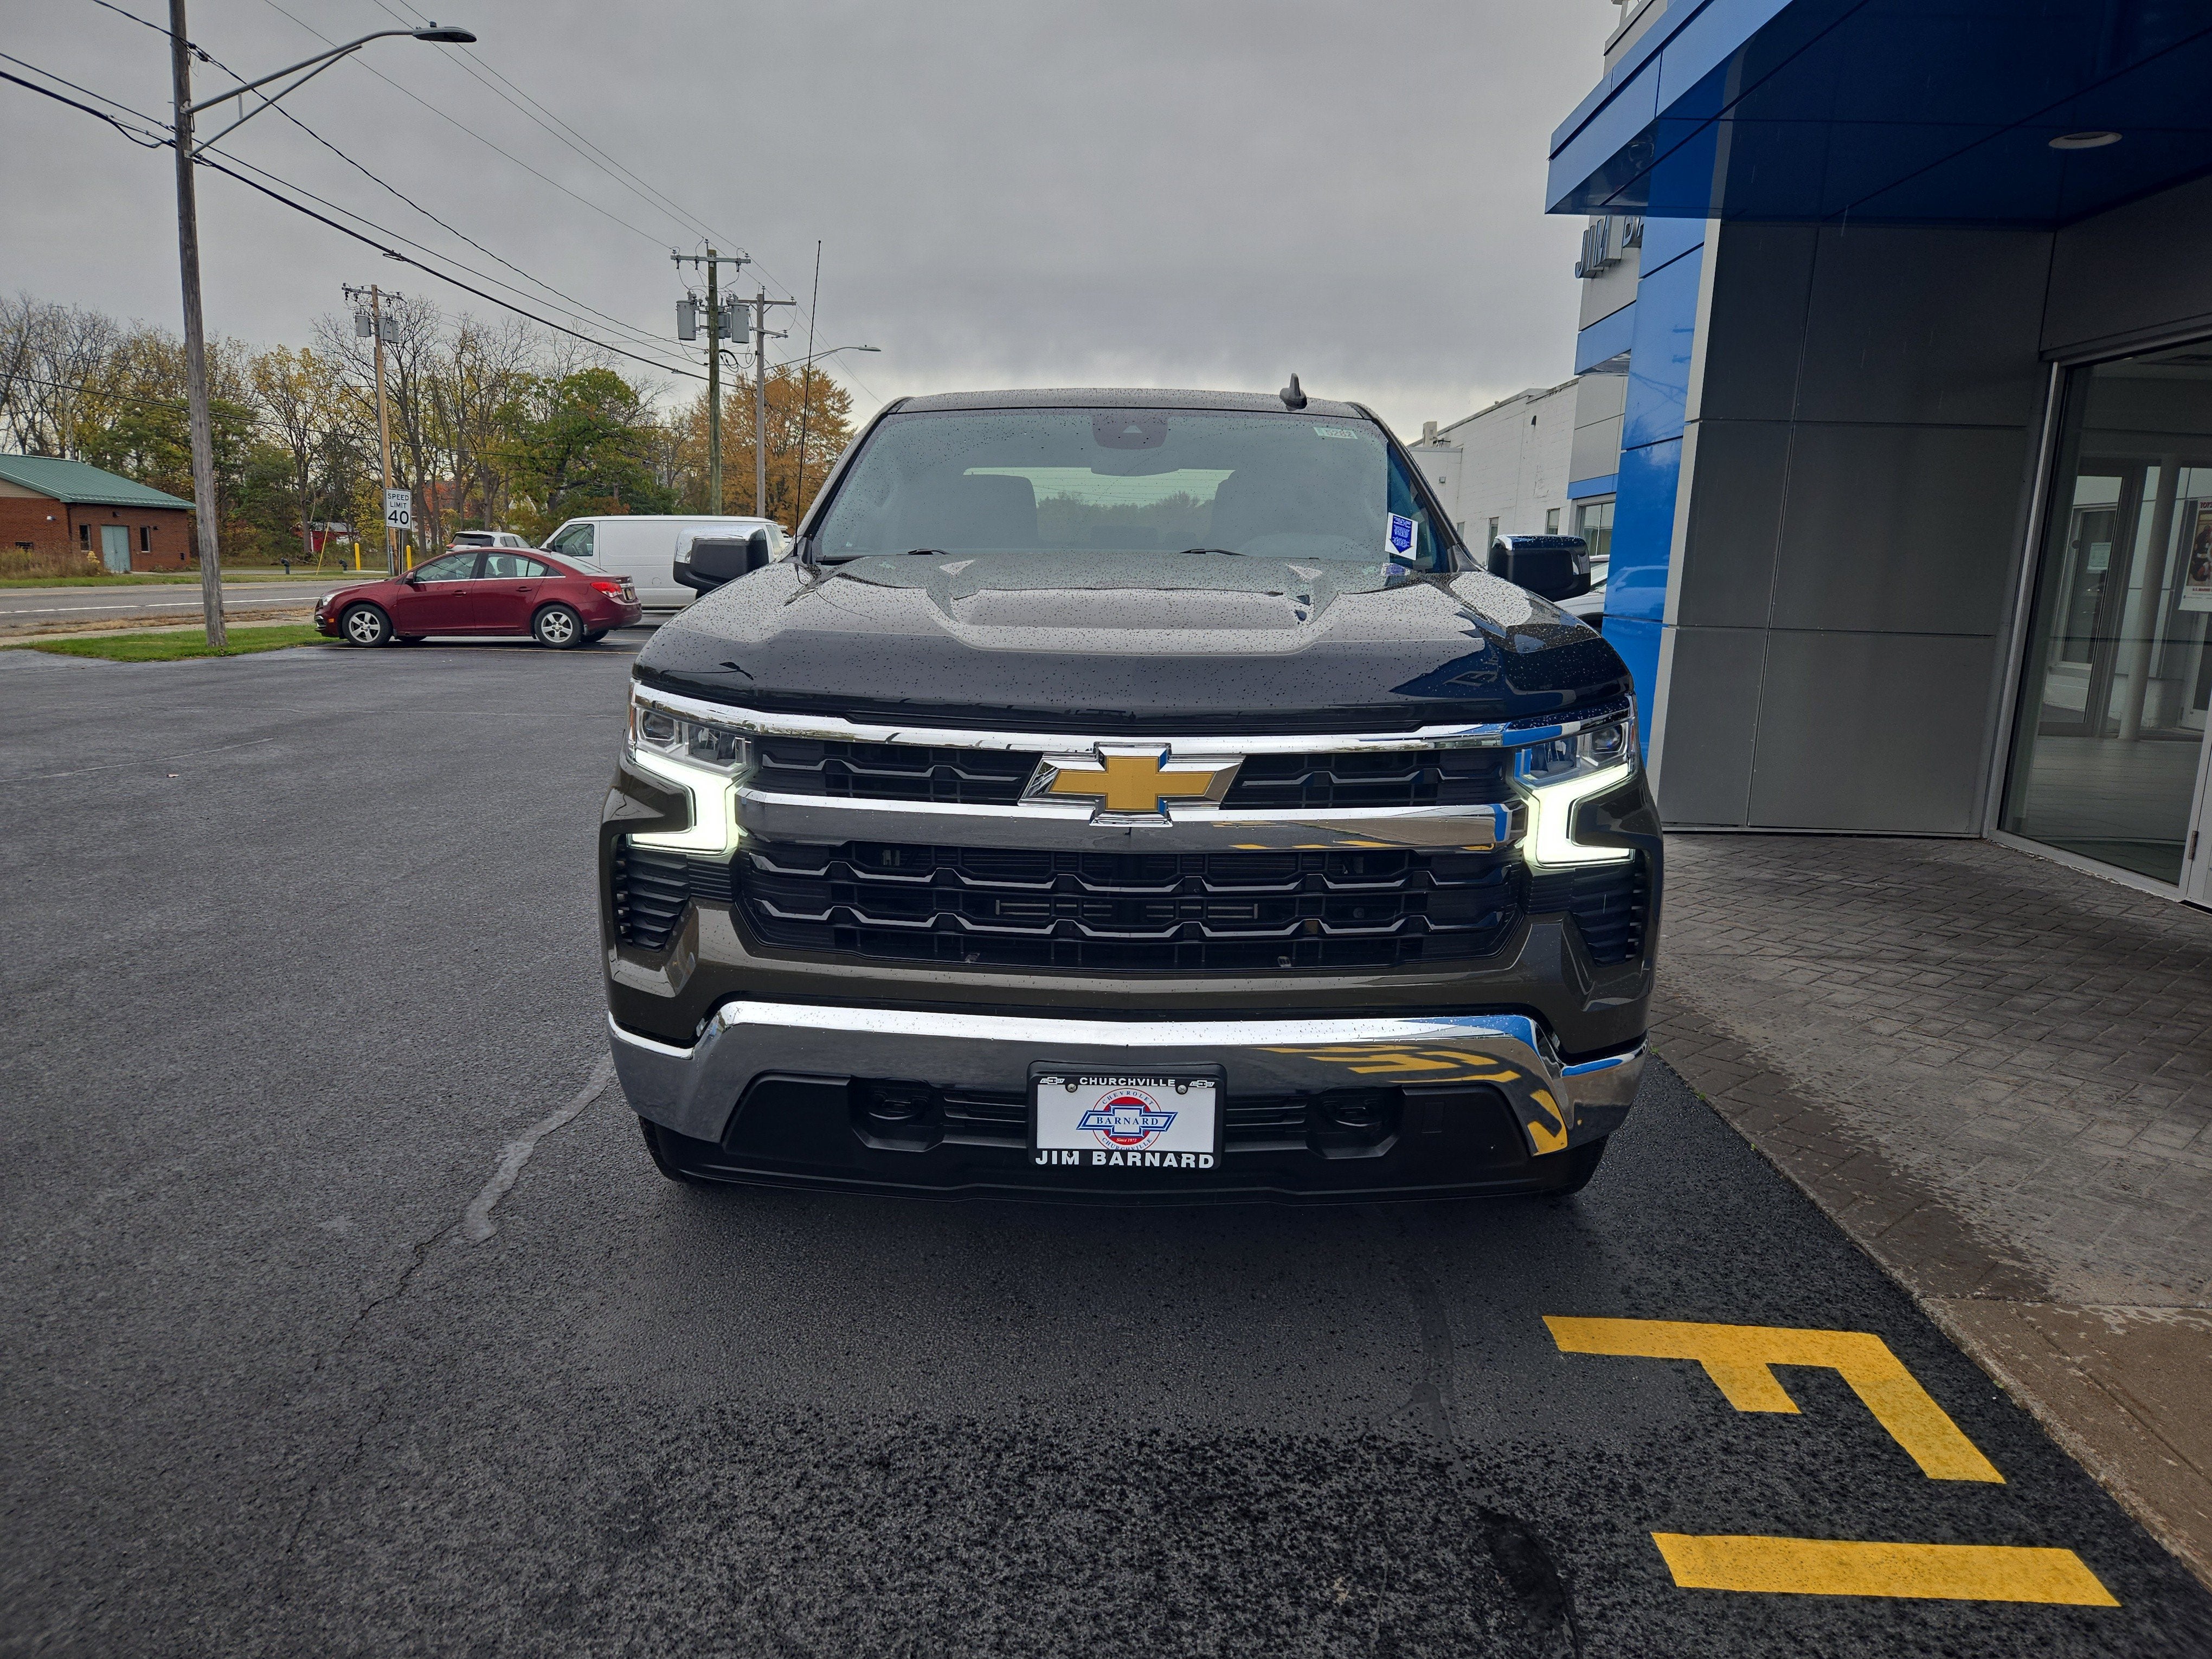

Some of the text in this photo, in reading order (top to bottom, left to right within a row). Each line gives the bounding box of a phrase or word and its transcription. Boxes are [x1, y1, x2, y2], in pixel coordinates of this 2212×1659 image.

[1574, 215, 1613, 279] JIM
[388, 510, 409, 525] 40
[1079, 1077, 1175, 1086] CHURCHVILLE
[1102, 1090, 1154, 1105] CHEVROLET
[1096, 1116, 1159, 1126] BARNARD
[1036, 1150, 1214, 1168] JIM BARNARD
